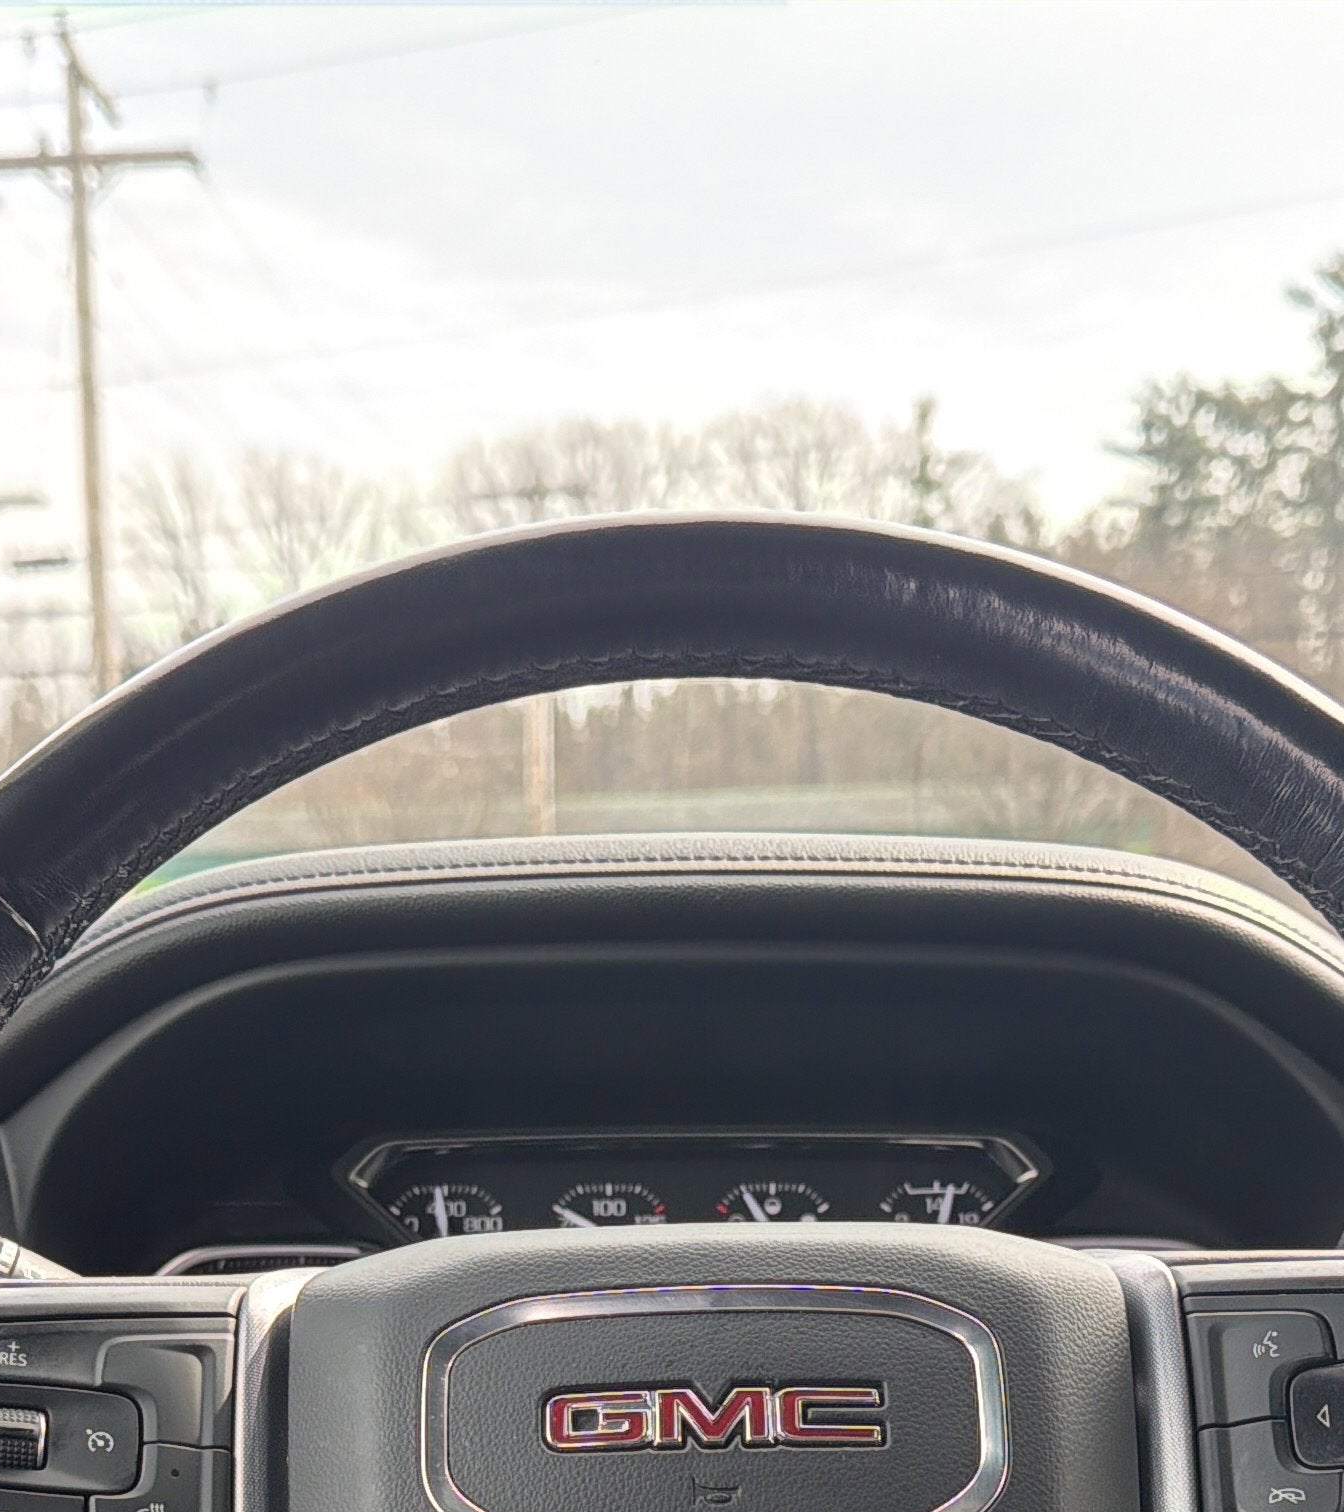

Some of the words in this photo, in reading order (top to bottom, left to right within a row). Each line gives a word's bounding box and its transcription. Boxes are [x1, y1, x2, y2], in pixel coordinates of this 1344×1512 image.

[591, 1199, 627, 1217] 100
[463, 1215, 504, 1232] 800
[0, 1351, 28, 1368] RES
[544, 1387, 883, 1450] GMC
